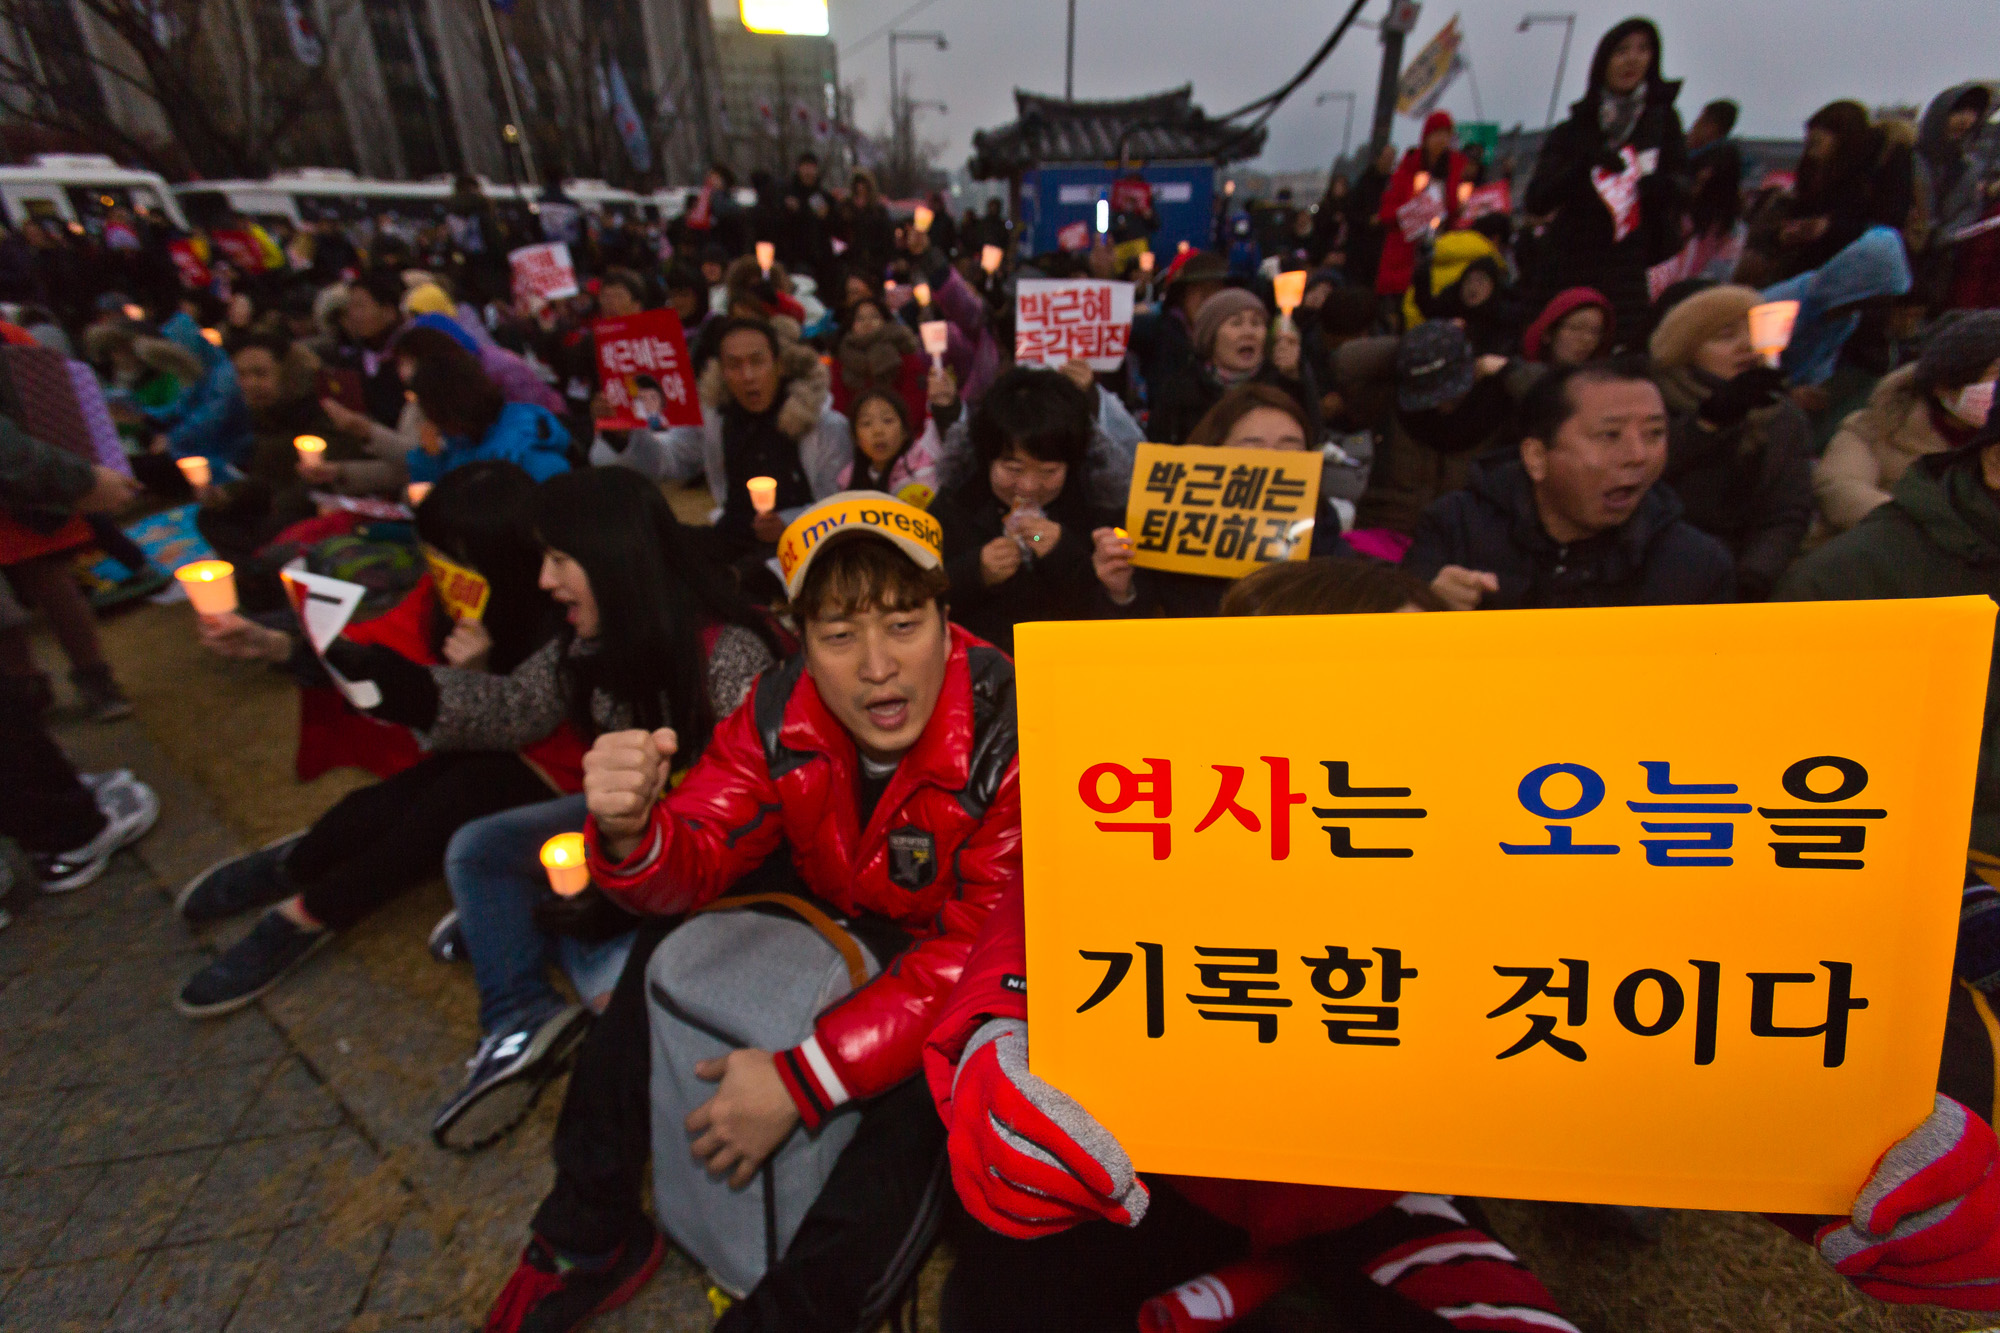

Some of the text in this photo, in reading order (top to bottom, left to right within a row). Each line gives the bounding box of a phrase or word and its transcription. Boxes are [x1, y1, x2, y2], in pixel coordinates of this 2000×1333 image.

[1146, 461, 1307, 513] 박근혜는
[1136, 508, 1301, 563] 퇴진하라
[1078, 755, 1888, 870] 역사는 오늘을
[1075, 941, 1869, 1069] 기록할 것이다
